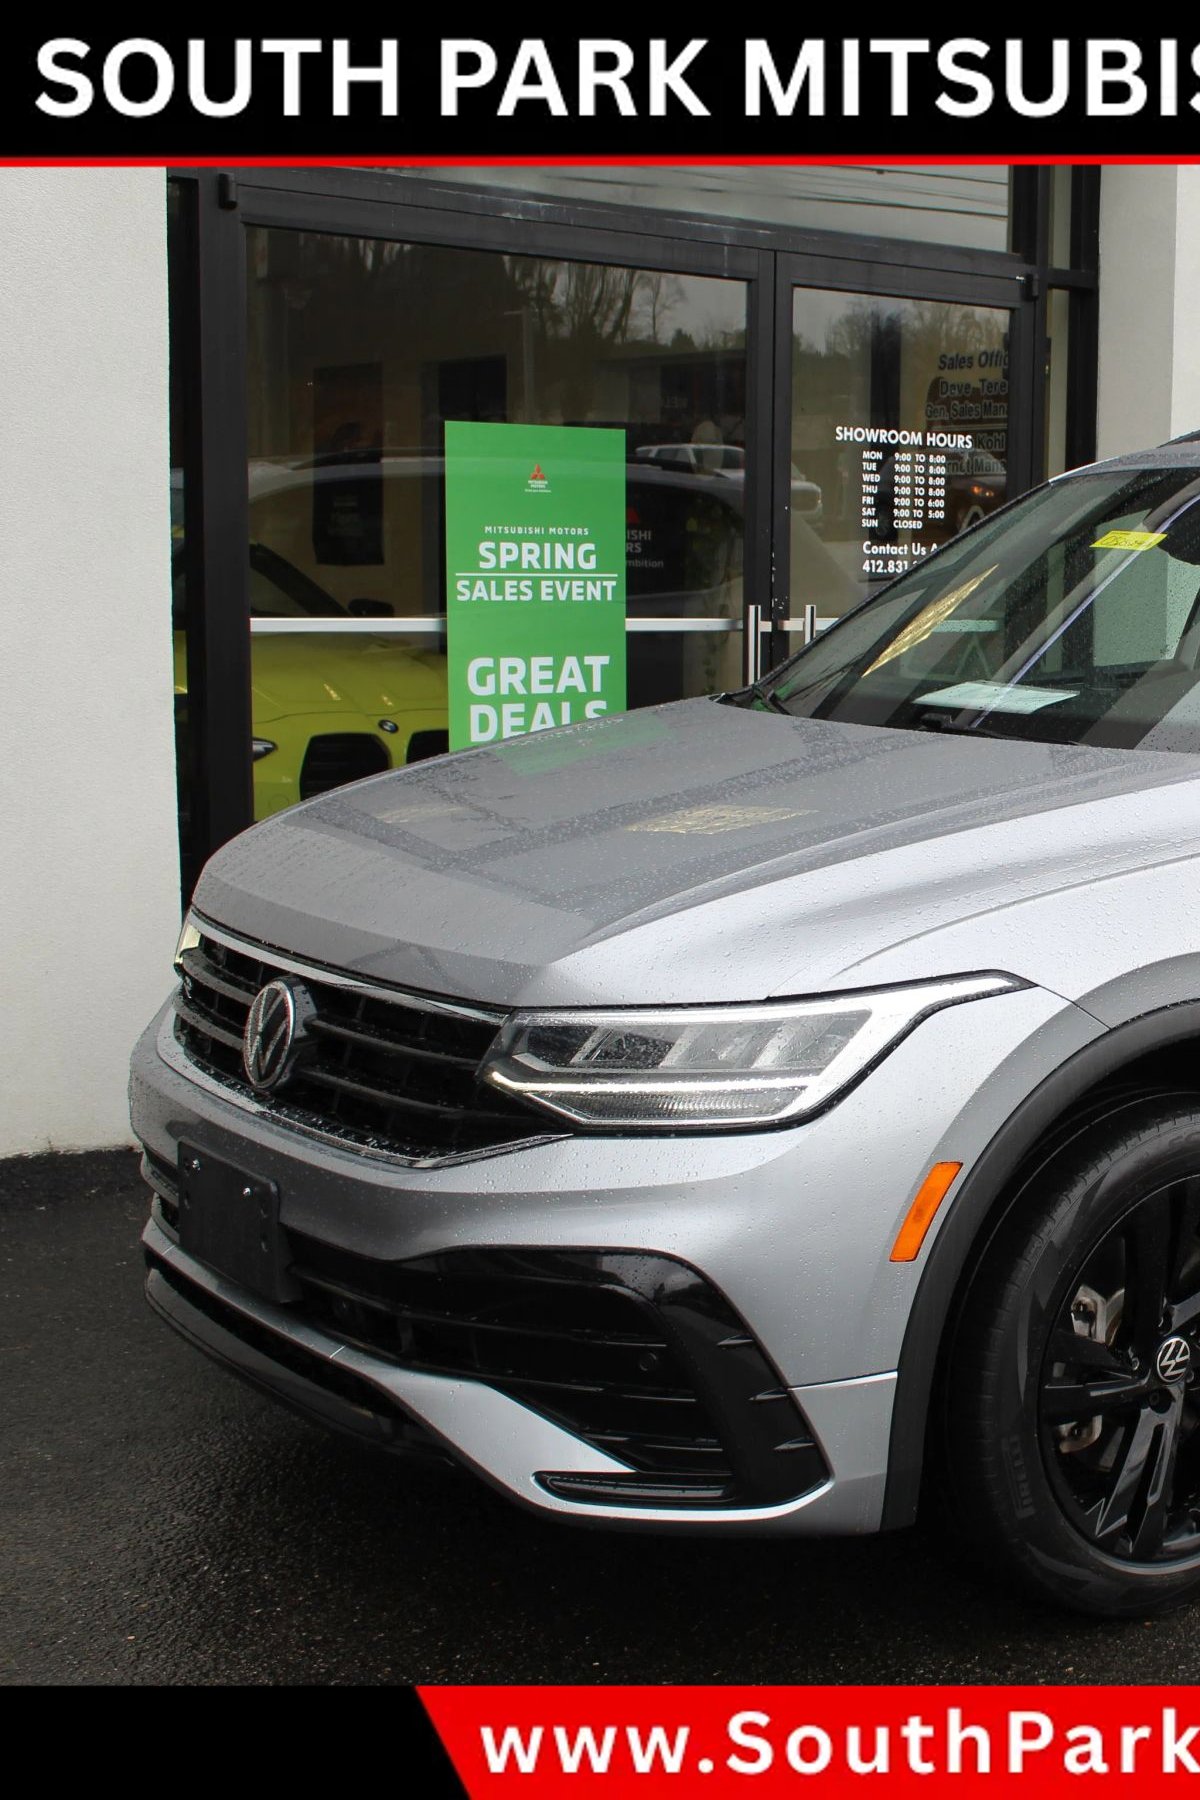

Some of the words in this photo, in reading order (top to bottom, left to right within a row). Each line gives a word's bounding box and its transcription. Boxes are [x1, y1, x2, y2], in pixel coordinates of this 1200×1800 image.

[938, 353, 974, 371] Sales
[951, 402, 980, 419] Sales
[835, 426, 923, 446] SHOWROOM
[926, 432, 973, 449] HOURS
[862, 451, 883, 460] MON
[894, 452, 912, 462] 9:00
[915, 454, 926, 462] TO
[929, 455, 946, 464] 8:00
[862, 462, 877, 471] TUE
[894, 464, 911, 473] 9:00
[914, 465, 925, 474] TO
[928, 466, 946, 475] 8:00
[862, 474, 881, 483] WED
[894, 475, 911, 484] 9:00
[914, 476, 925, 485] TO
[928, 477, 946, 486] 8:00
[862, 485, 878, 494] THU
[893, 486, 911, 495] 9:00
[914, 487, 925, 496] TO
[928, 488, 945, 497] 8:00
[862, 496, 874, 505] FRI
[893, 497, 911, 507] 9:00
[914, 498, 924, 507] TO
[927, 499, 945, 508] 6:00
[862, 507, 876, 516] SAT
[893, 508, 910, 518] 9:00
[913, 509, 923, 518] TO
[927, 510, 945, 519] 5:00
[861, 518, 878, 528] SUN
[893, 520, 923, 529] CLOSED
[485, 526, 545, 535] MITSUBISHI
[549, 527, 589, 536] MOTORS
[862, 540, 908, 555] Contact
[911, 542, 927, 556] Us
[478, 541, 597, 570] SPRING
[456, 580, 533, 602] SALES
[540, 580, 617, 601] EVENT
[467, 655, 611, 697] GREAT
